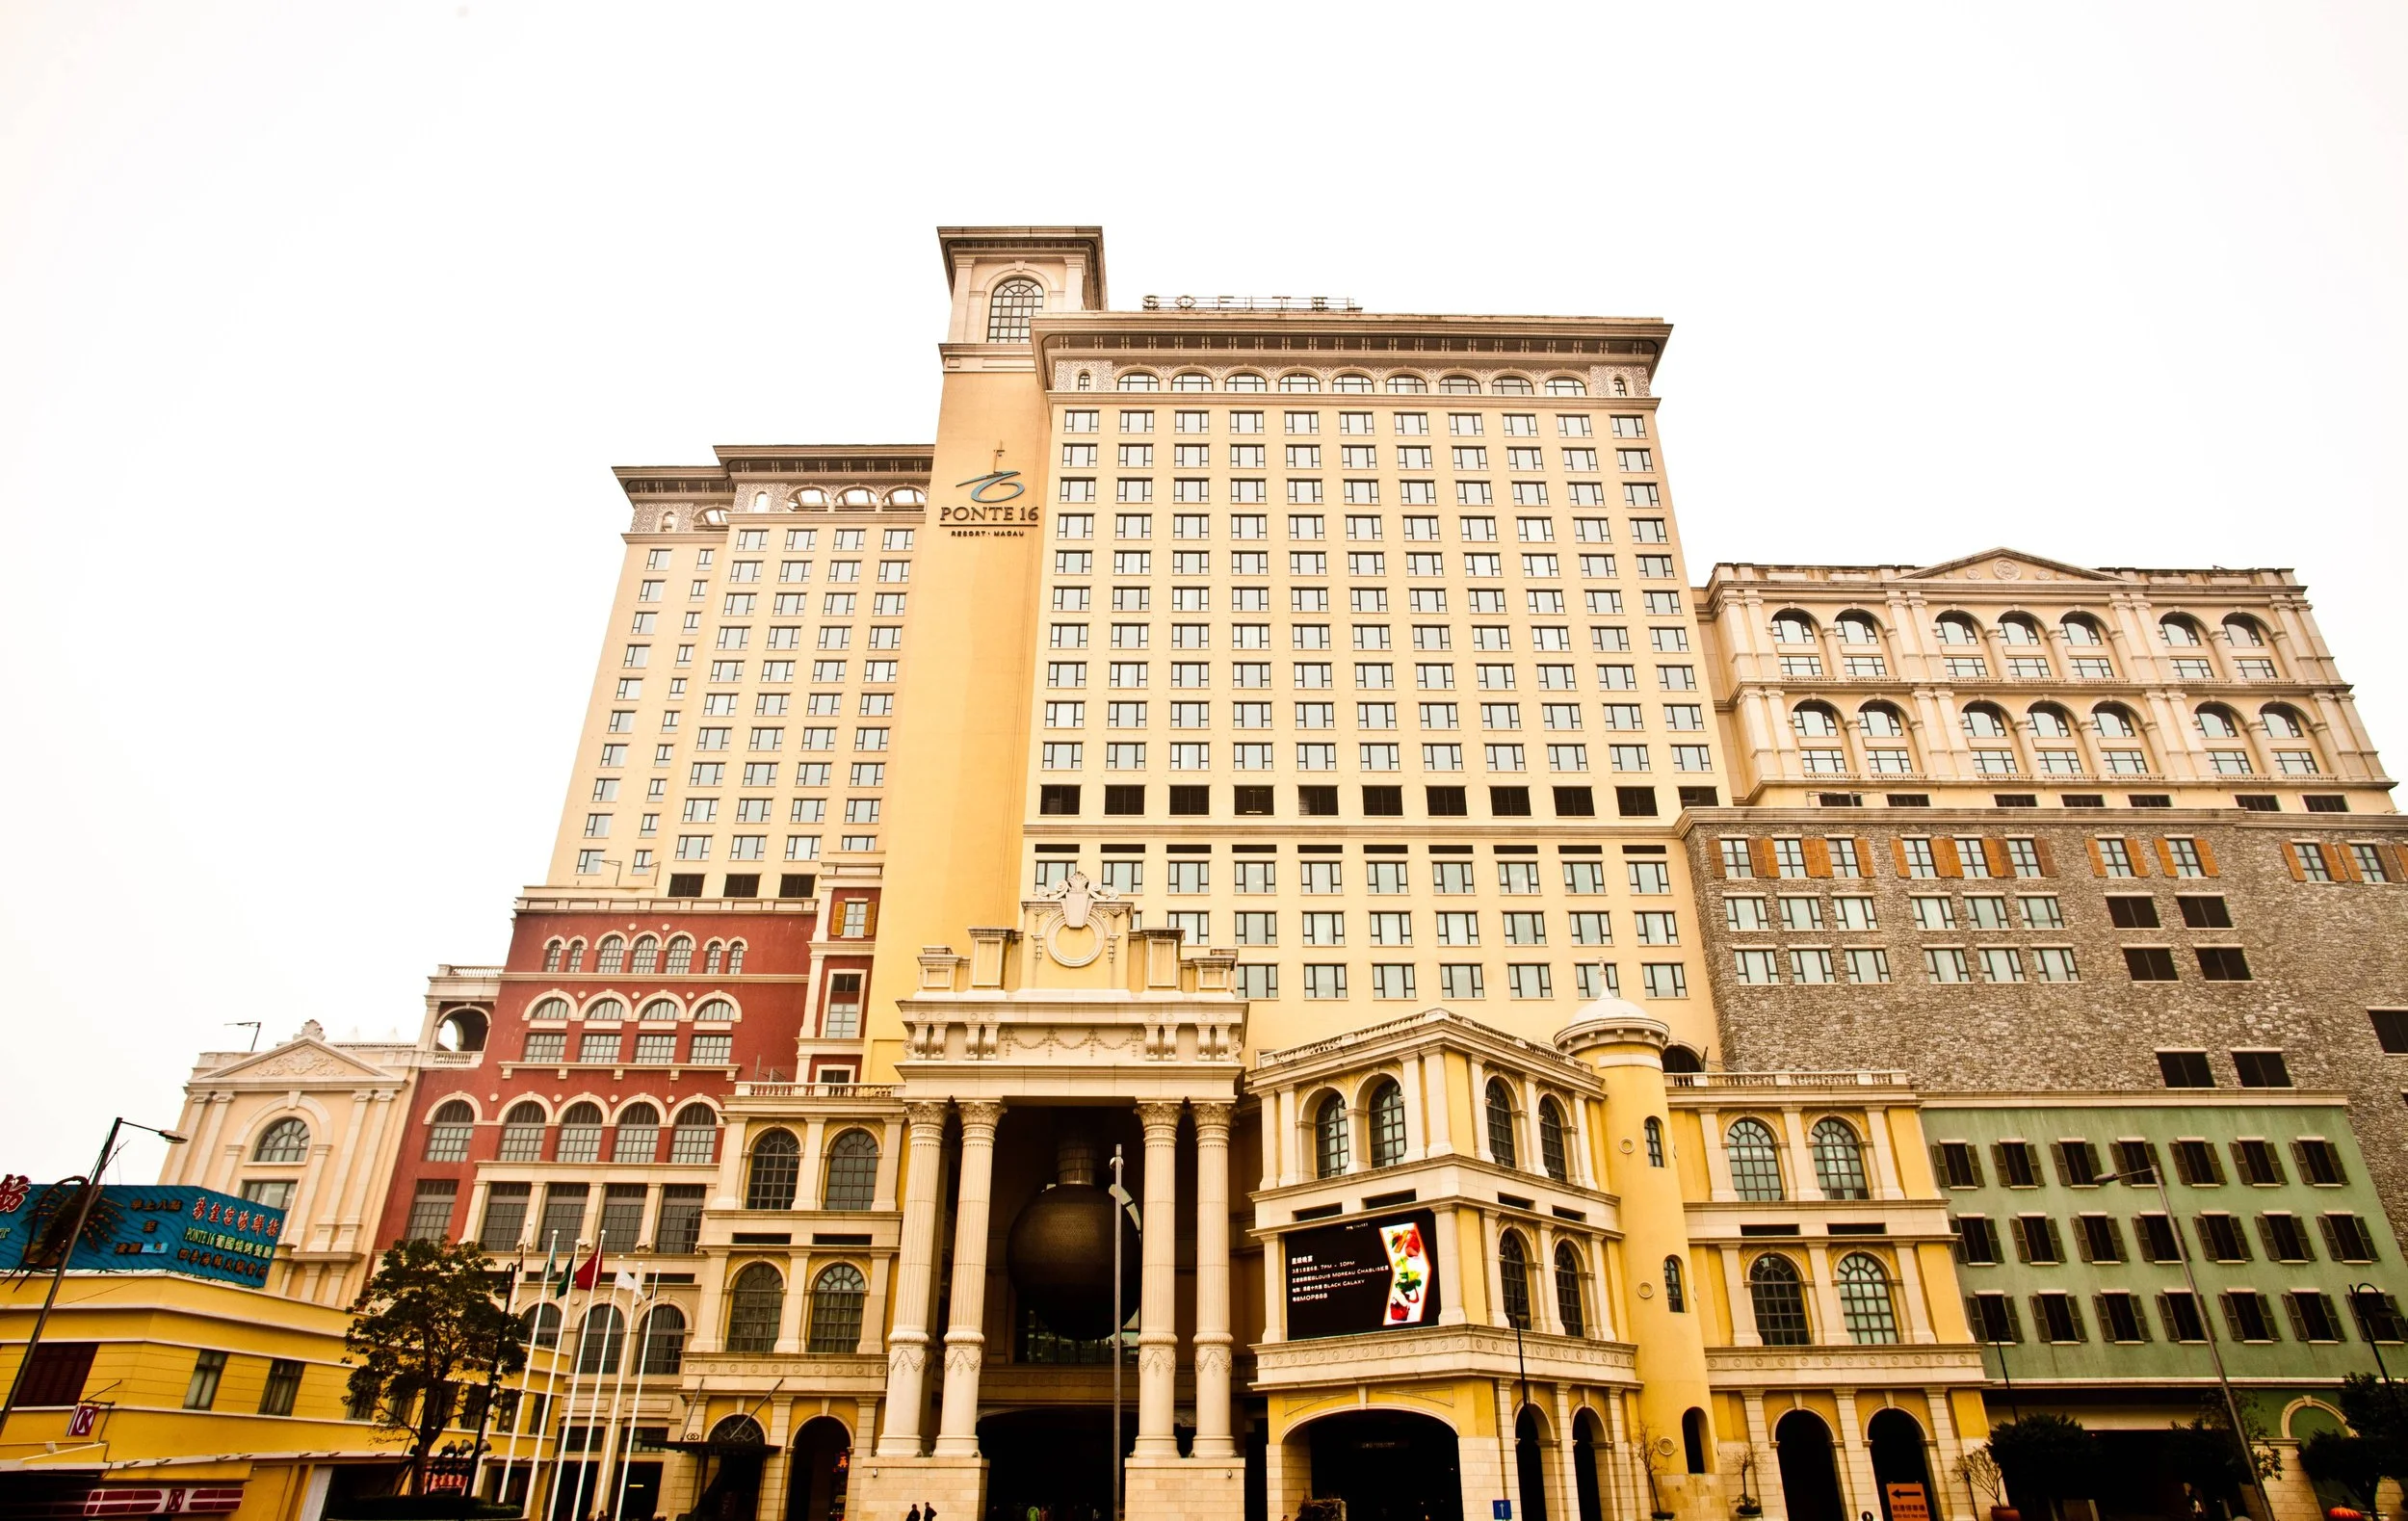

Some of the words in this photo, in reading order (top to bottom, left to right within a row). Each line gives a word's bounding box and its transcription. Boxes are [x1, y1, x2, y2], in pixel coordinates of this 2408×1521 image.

[1142, 295, 1363, 311] SOFITEL
[940, 507, 1014, 521] PONTE
[1019, 507, 1038, 521] 16
